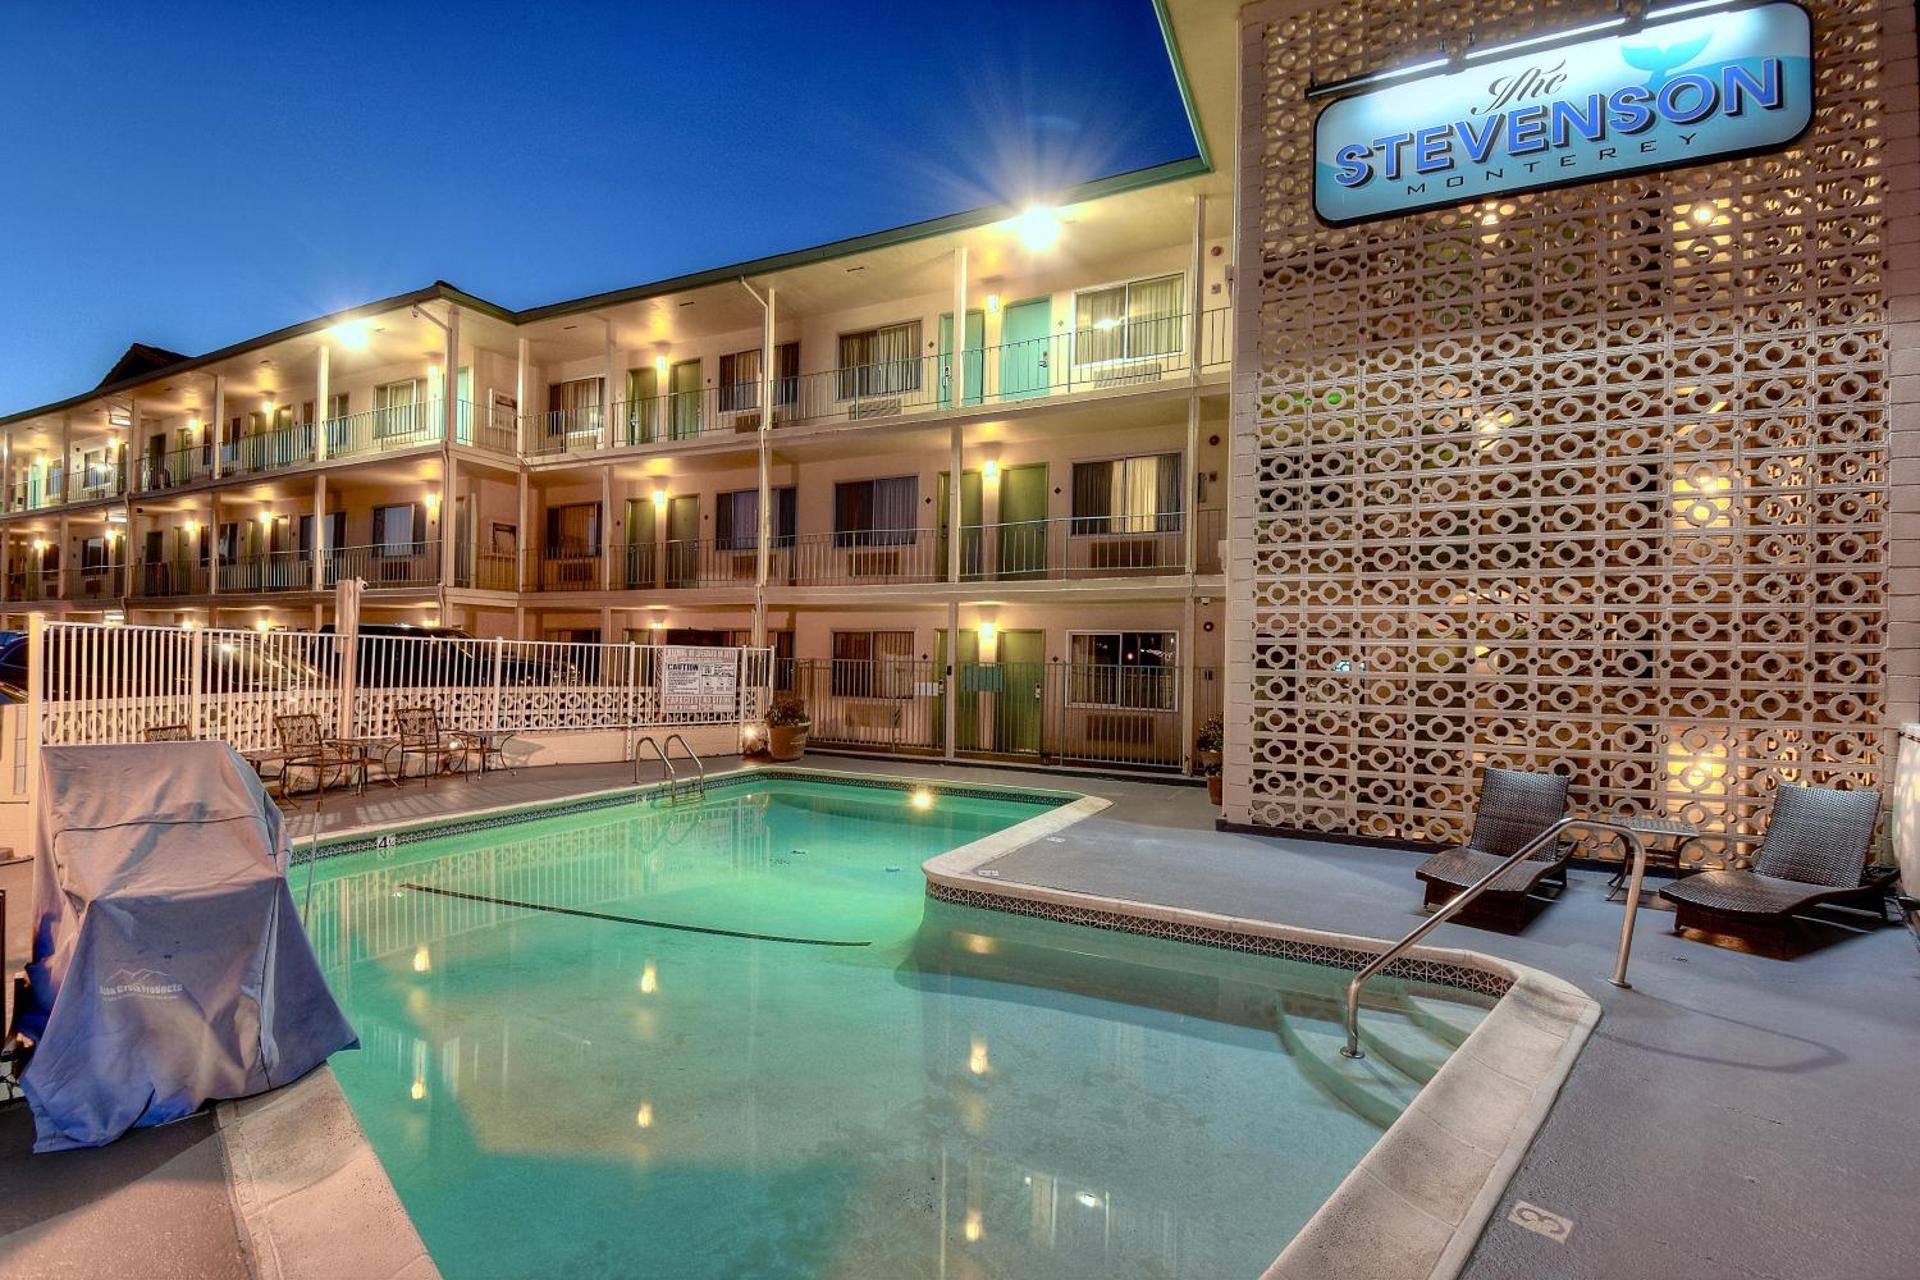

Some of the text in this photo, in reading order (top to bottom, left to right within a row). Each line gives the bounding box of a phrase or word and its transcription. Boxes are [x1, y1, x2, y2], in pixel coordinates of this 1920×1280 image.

[1471, 59, 1567, 115] The
[1335, 57, 1783, 189] STEVENSON
[1407, 132, 1697, 196] MONTEREY
[667, 663, 699, 671] CAUTION
